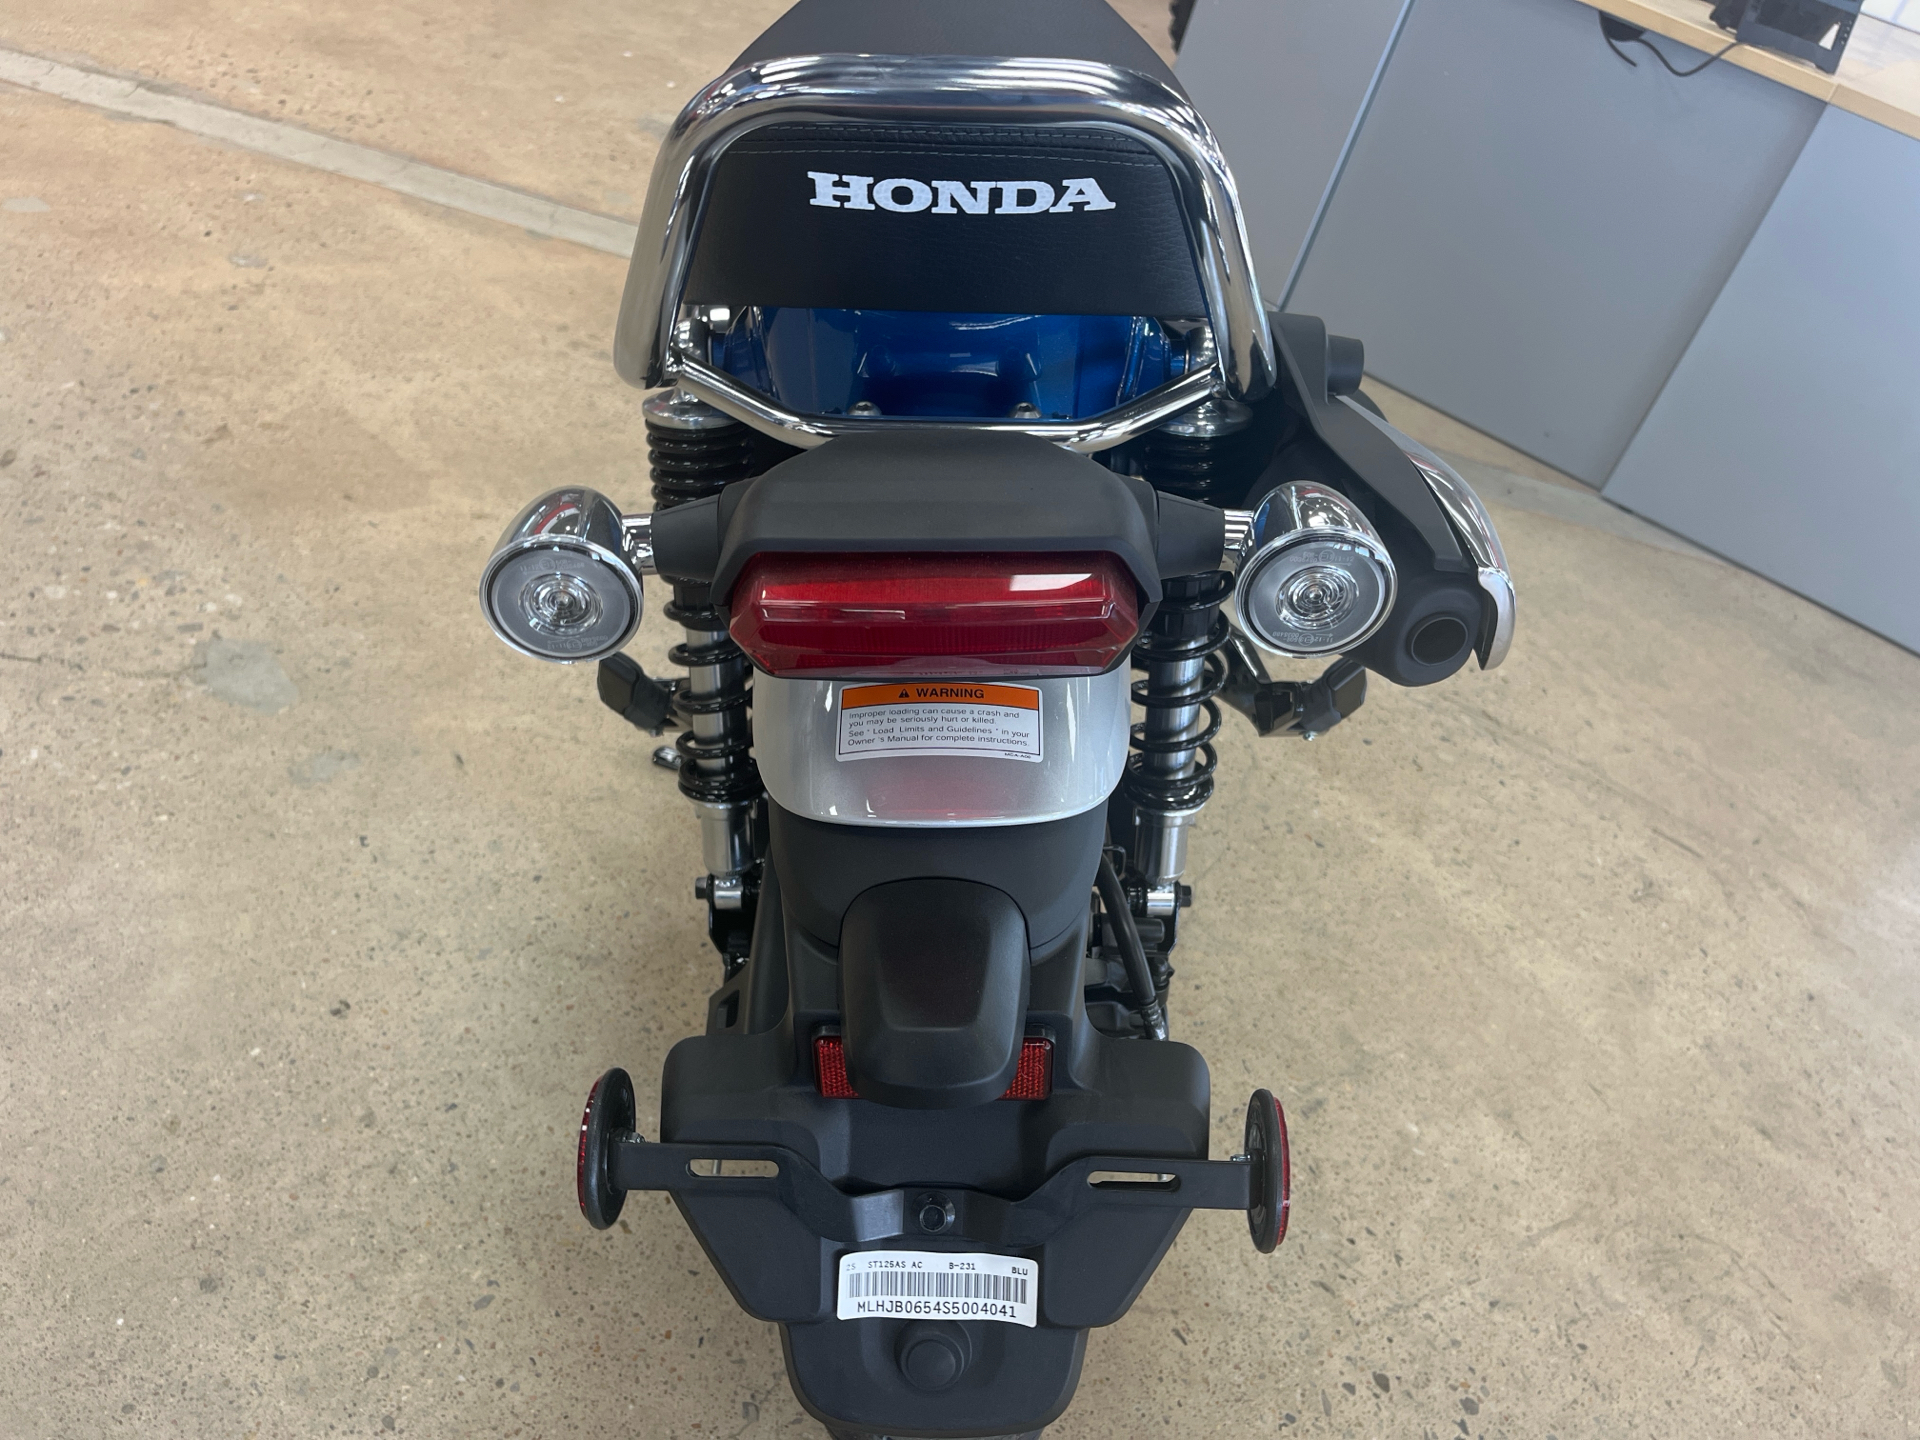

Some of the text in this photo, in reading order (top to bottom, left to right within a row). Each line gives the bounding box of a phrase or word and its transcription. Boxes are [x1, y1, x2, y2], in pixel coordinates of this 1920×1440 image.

[807, 171, 1116, 214] HONDA
[916, 688, 984, 699] WARNING
[849, 710, 886, 719] Improper
[889, 708, 919, 716] loading
[848, 720, 864, 729] you
[900, 715, 938, 724] seriously
[887, 734, 919, 742] Manual
[1011, 731, 1030, 739] your
[867, 1261, 907, 1269] ST125AS
[911, 1261, 923, 1269] AC
[948, 1262, 976, 1271] B-231
[1011, 1266, 1029, 1276] BLU
[857, 1300, 1017, 1318] MLHJB0654S5004041
